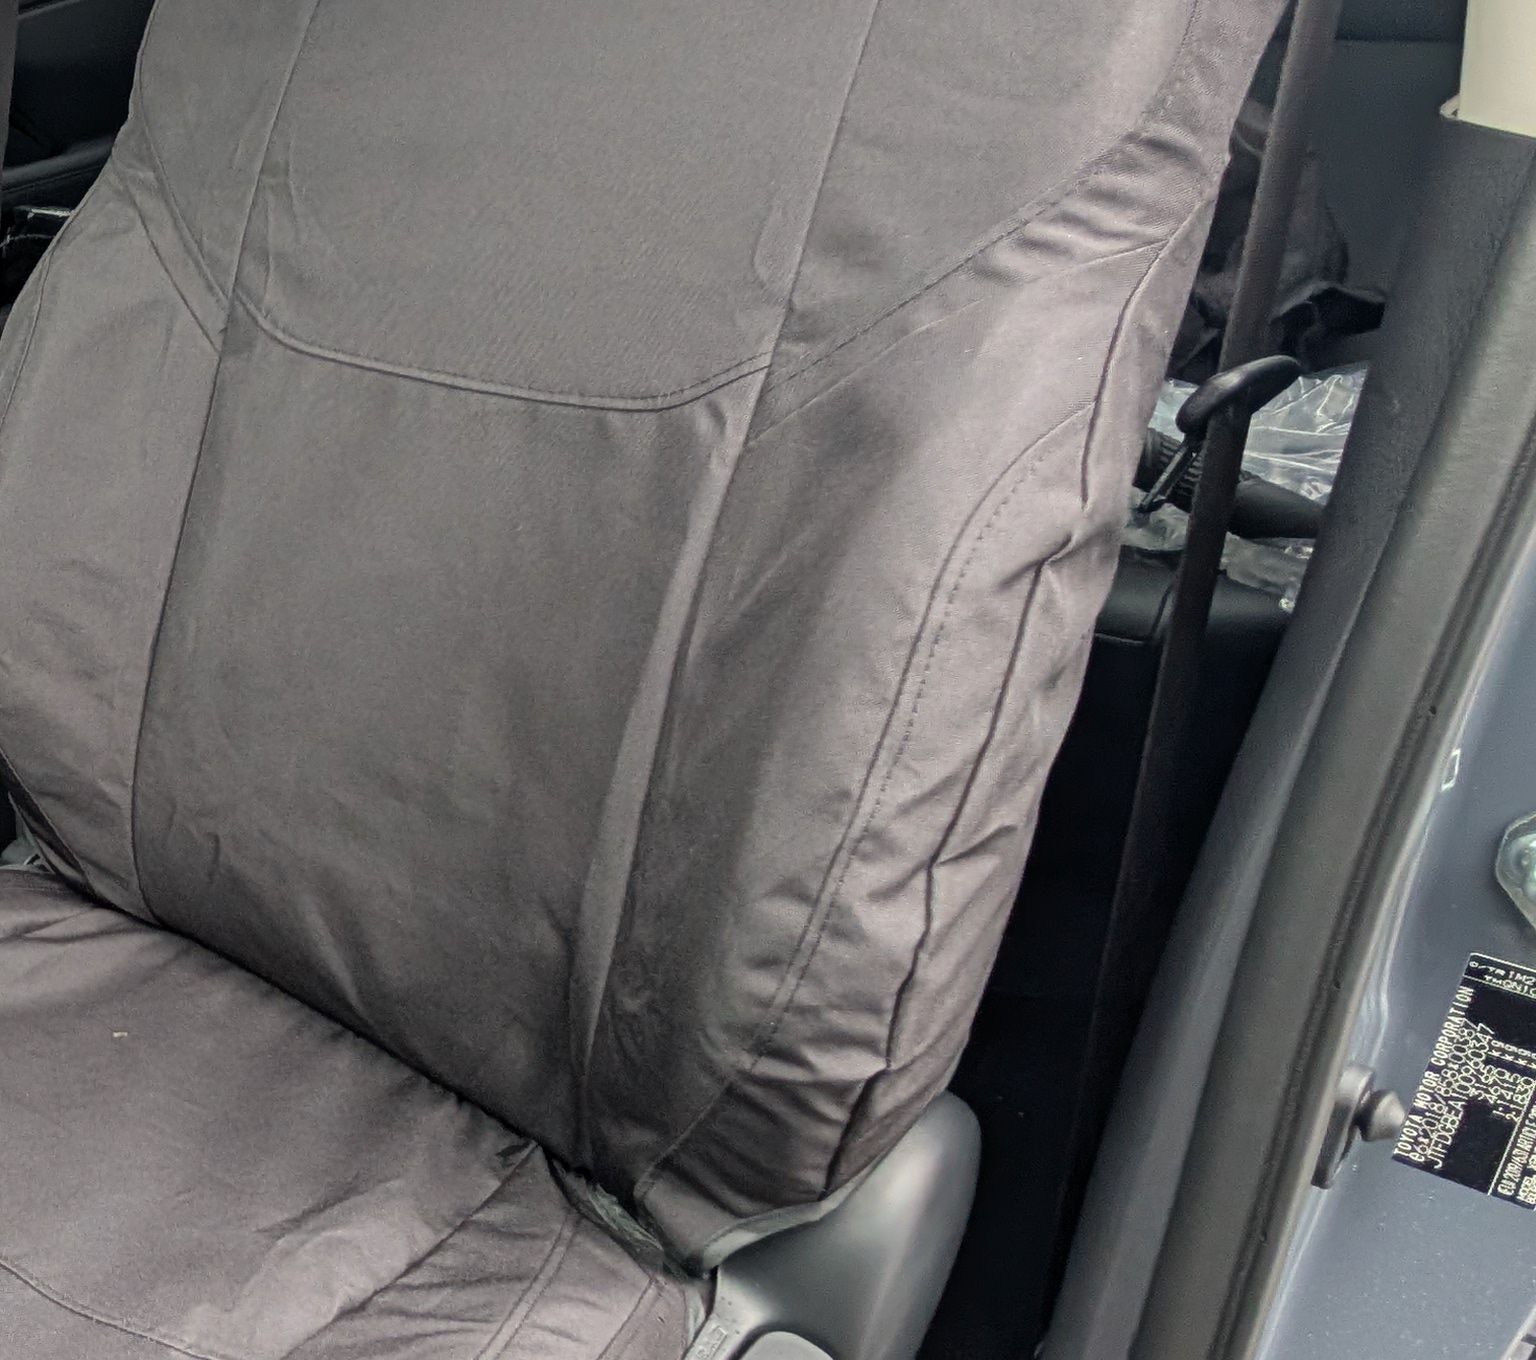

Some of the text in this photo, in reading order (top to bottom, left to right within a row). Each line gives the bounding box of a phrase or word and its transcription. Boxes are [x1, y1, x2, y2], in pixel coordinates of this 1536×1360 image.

[1394, 985, 1474, 1156] TOYOTA MOTOR CORPORATION
